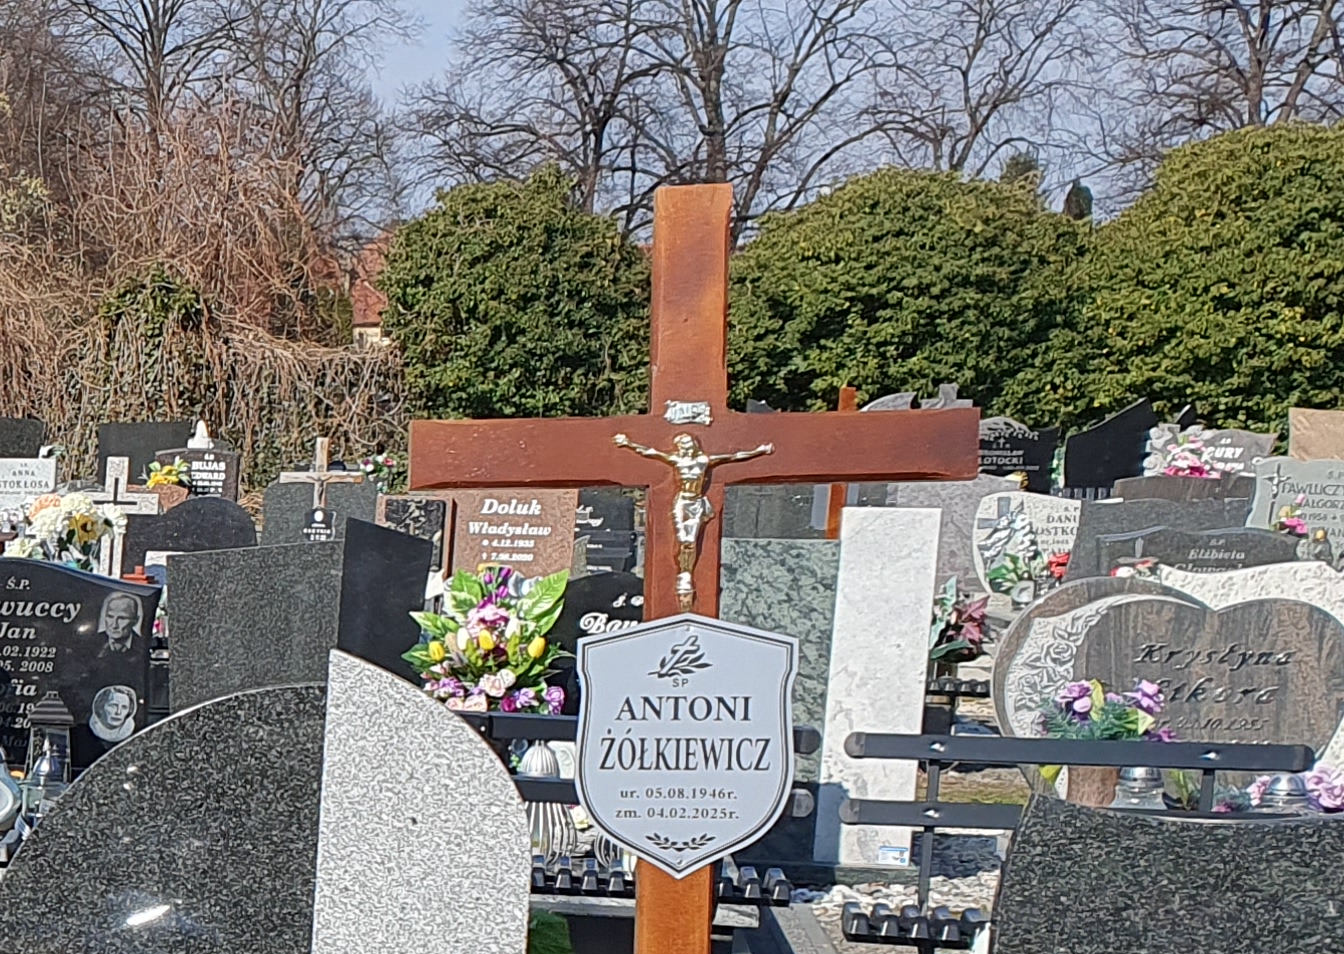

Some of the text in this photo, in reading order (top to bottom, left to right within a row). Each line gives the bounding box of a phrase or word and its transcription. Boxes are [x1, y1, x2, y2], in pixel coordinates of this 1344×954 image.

[480, 498, 543, 516] Doluk
[468, 521, 552, 537] Władysław
[1133, 641, 1297, 672] Krystyna
[614, 695, 753, 722] ANTONI
[599, 727, 772, 772] ŻÓŁKIEWICZ
[620, 787, 738, 801] ur. 05.08.1946r.
[615, 807, 740, 820] zm. 04.02.2025r.
